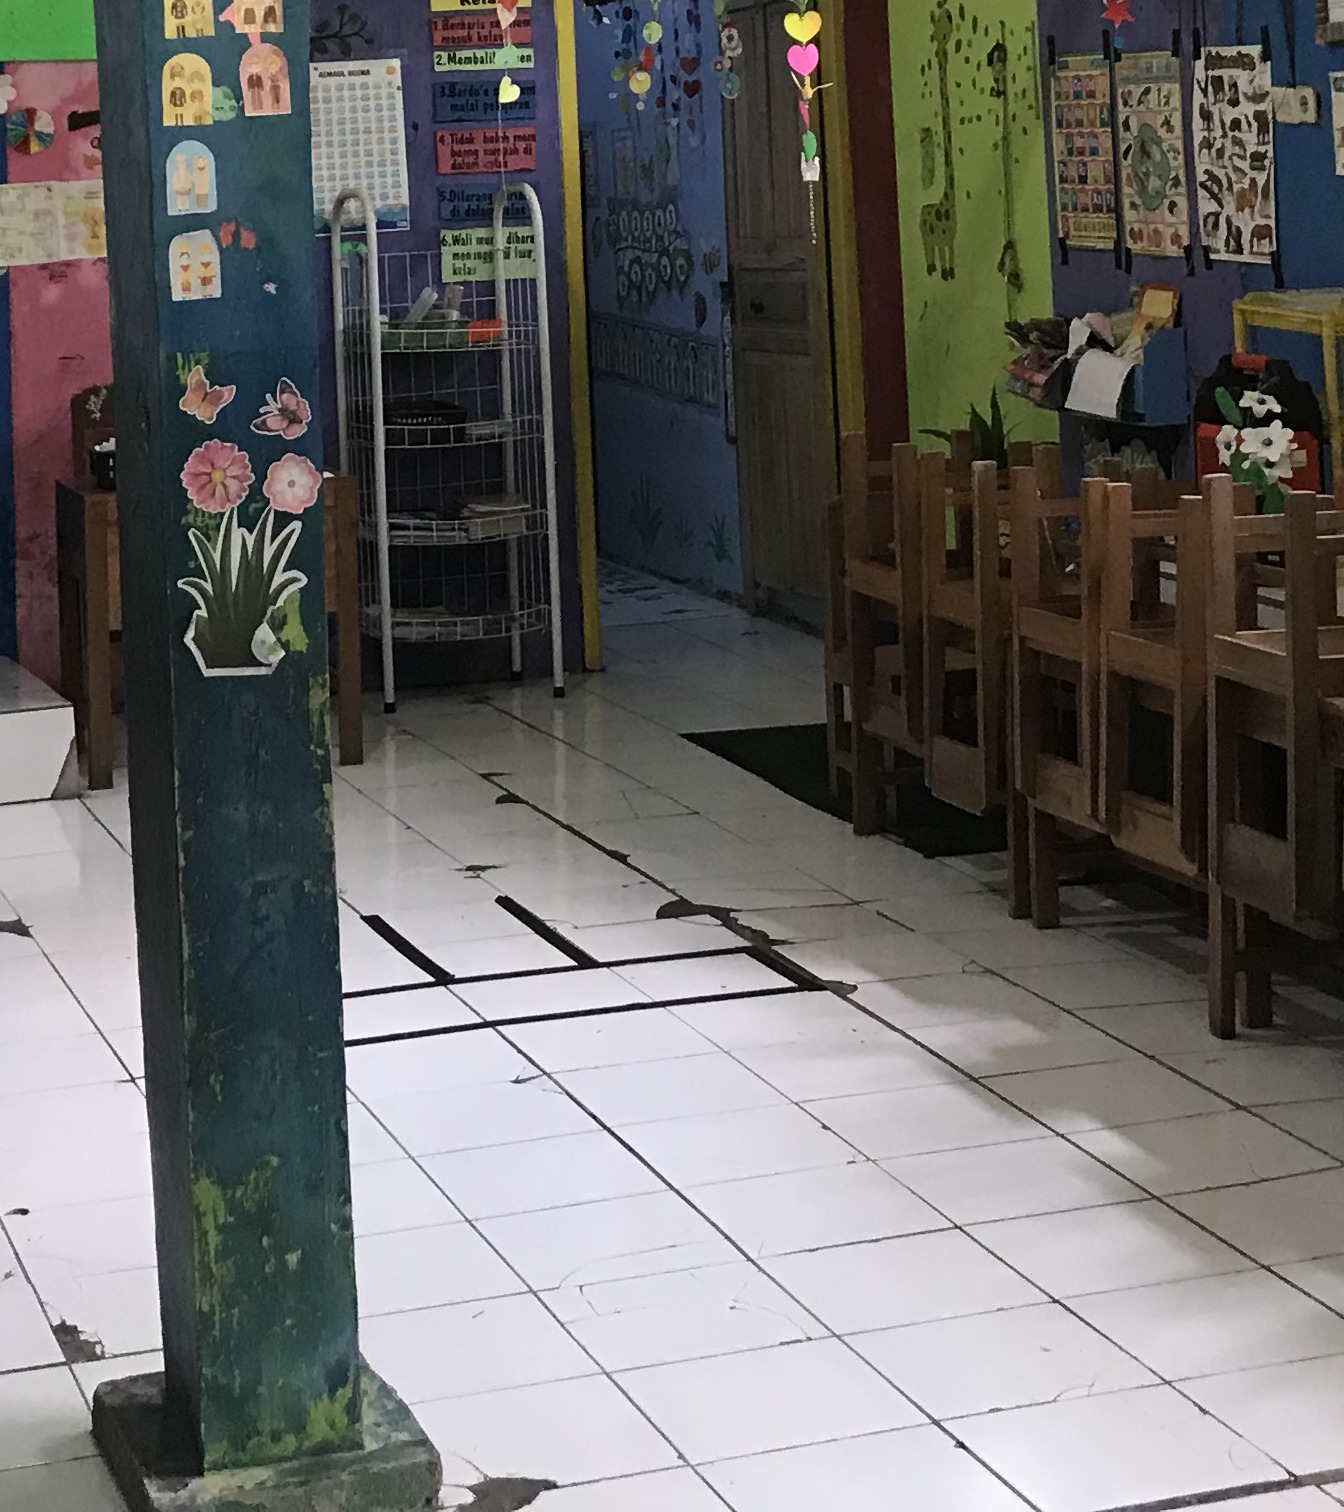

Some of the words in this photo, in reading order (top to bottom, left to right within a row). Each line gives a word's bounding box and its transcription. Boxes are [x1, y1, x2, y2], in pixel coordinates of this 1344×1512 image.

[435, 52, 496, 67] 2.Membali
[450, 205, 460, 218] di
[503, 203, 526, 216] elas
